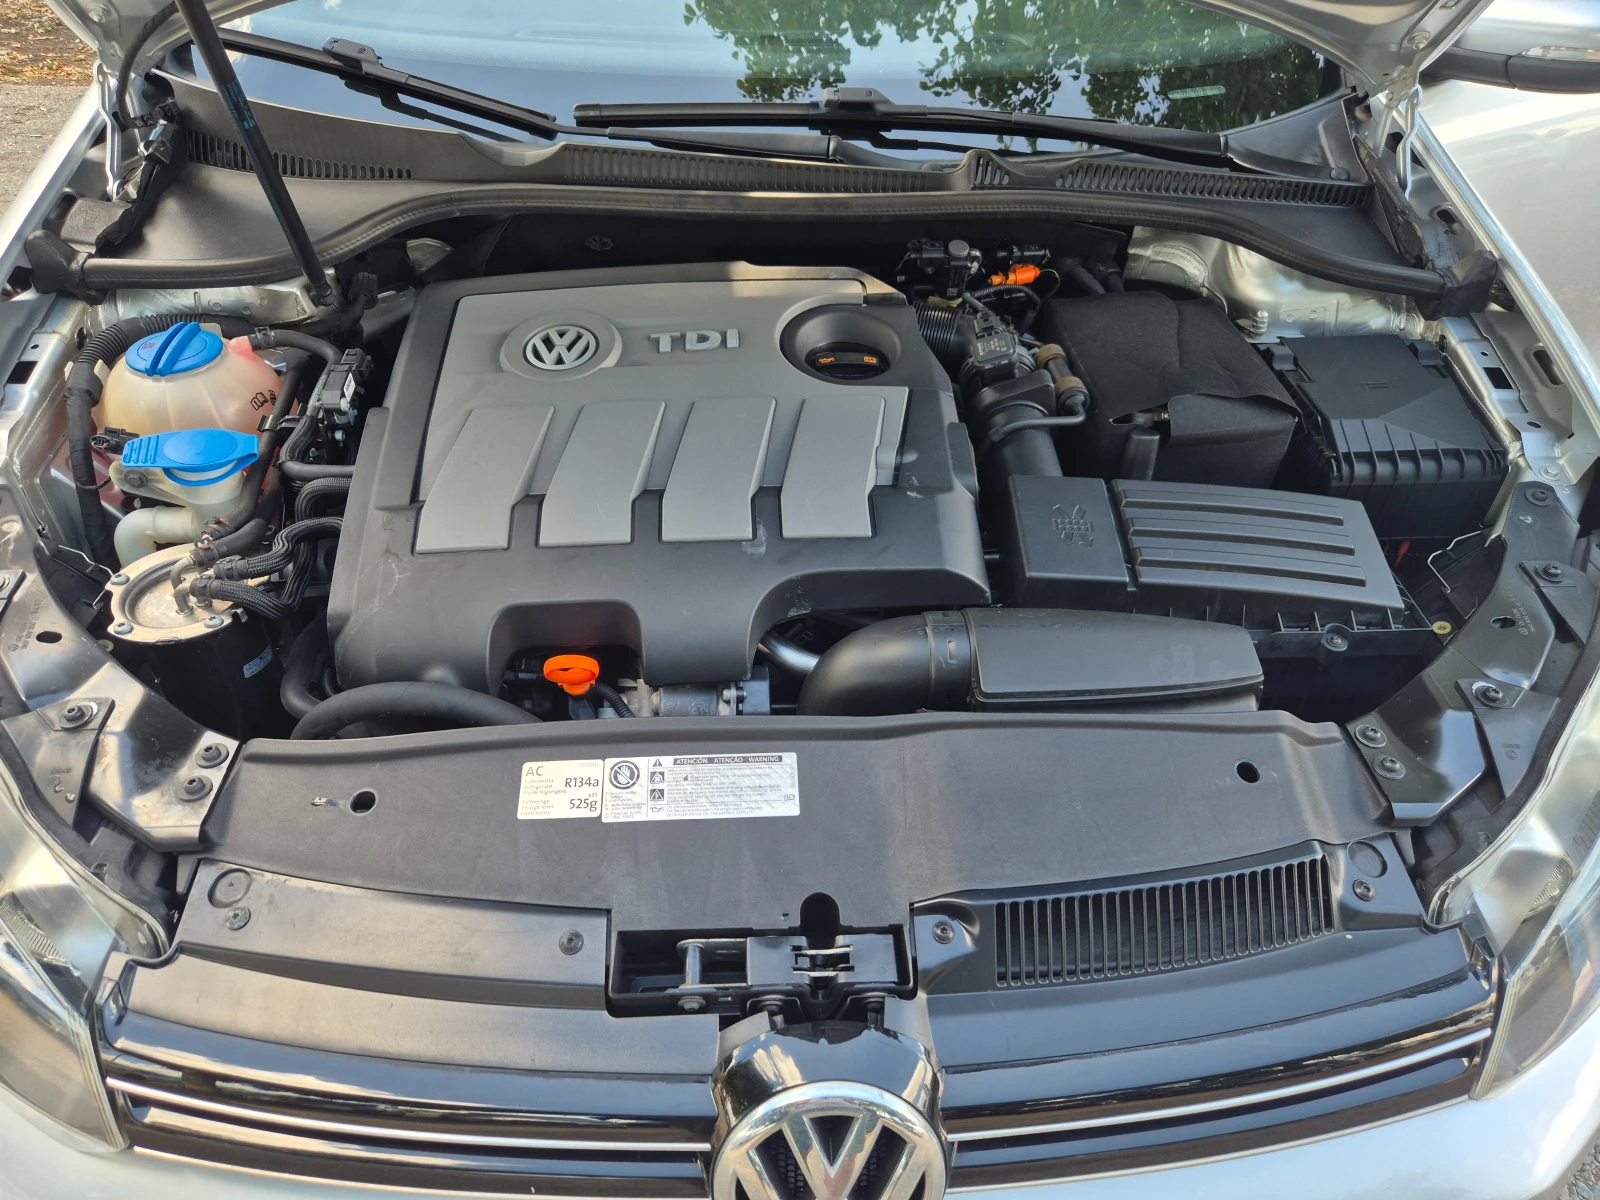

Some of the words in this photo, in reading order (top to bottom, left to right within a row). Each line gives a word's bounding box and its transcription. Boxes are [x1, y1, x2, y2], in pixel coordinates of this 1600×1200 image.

[649, 328, 740, 354] TDI
[676, 757, 708, 765] ATENCIÓN
[713, 756, 744, 764] ATENÇÃO
[748, 755, 779, 763] WARNING
[525, 766, 544, 777] AC
[564, 777, 599, 788] R134a
[569, 798, 598, 812] 525g
